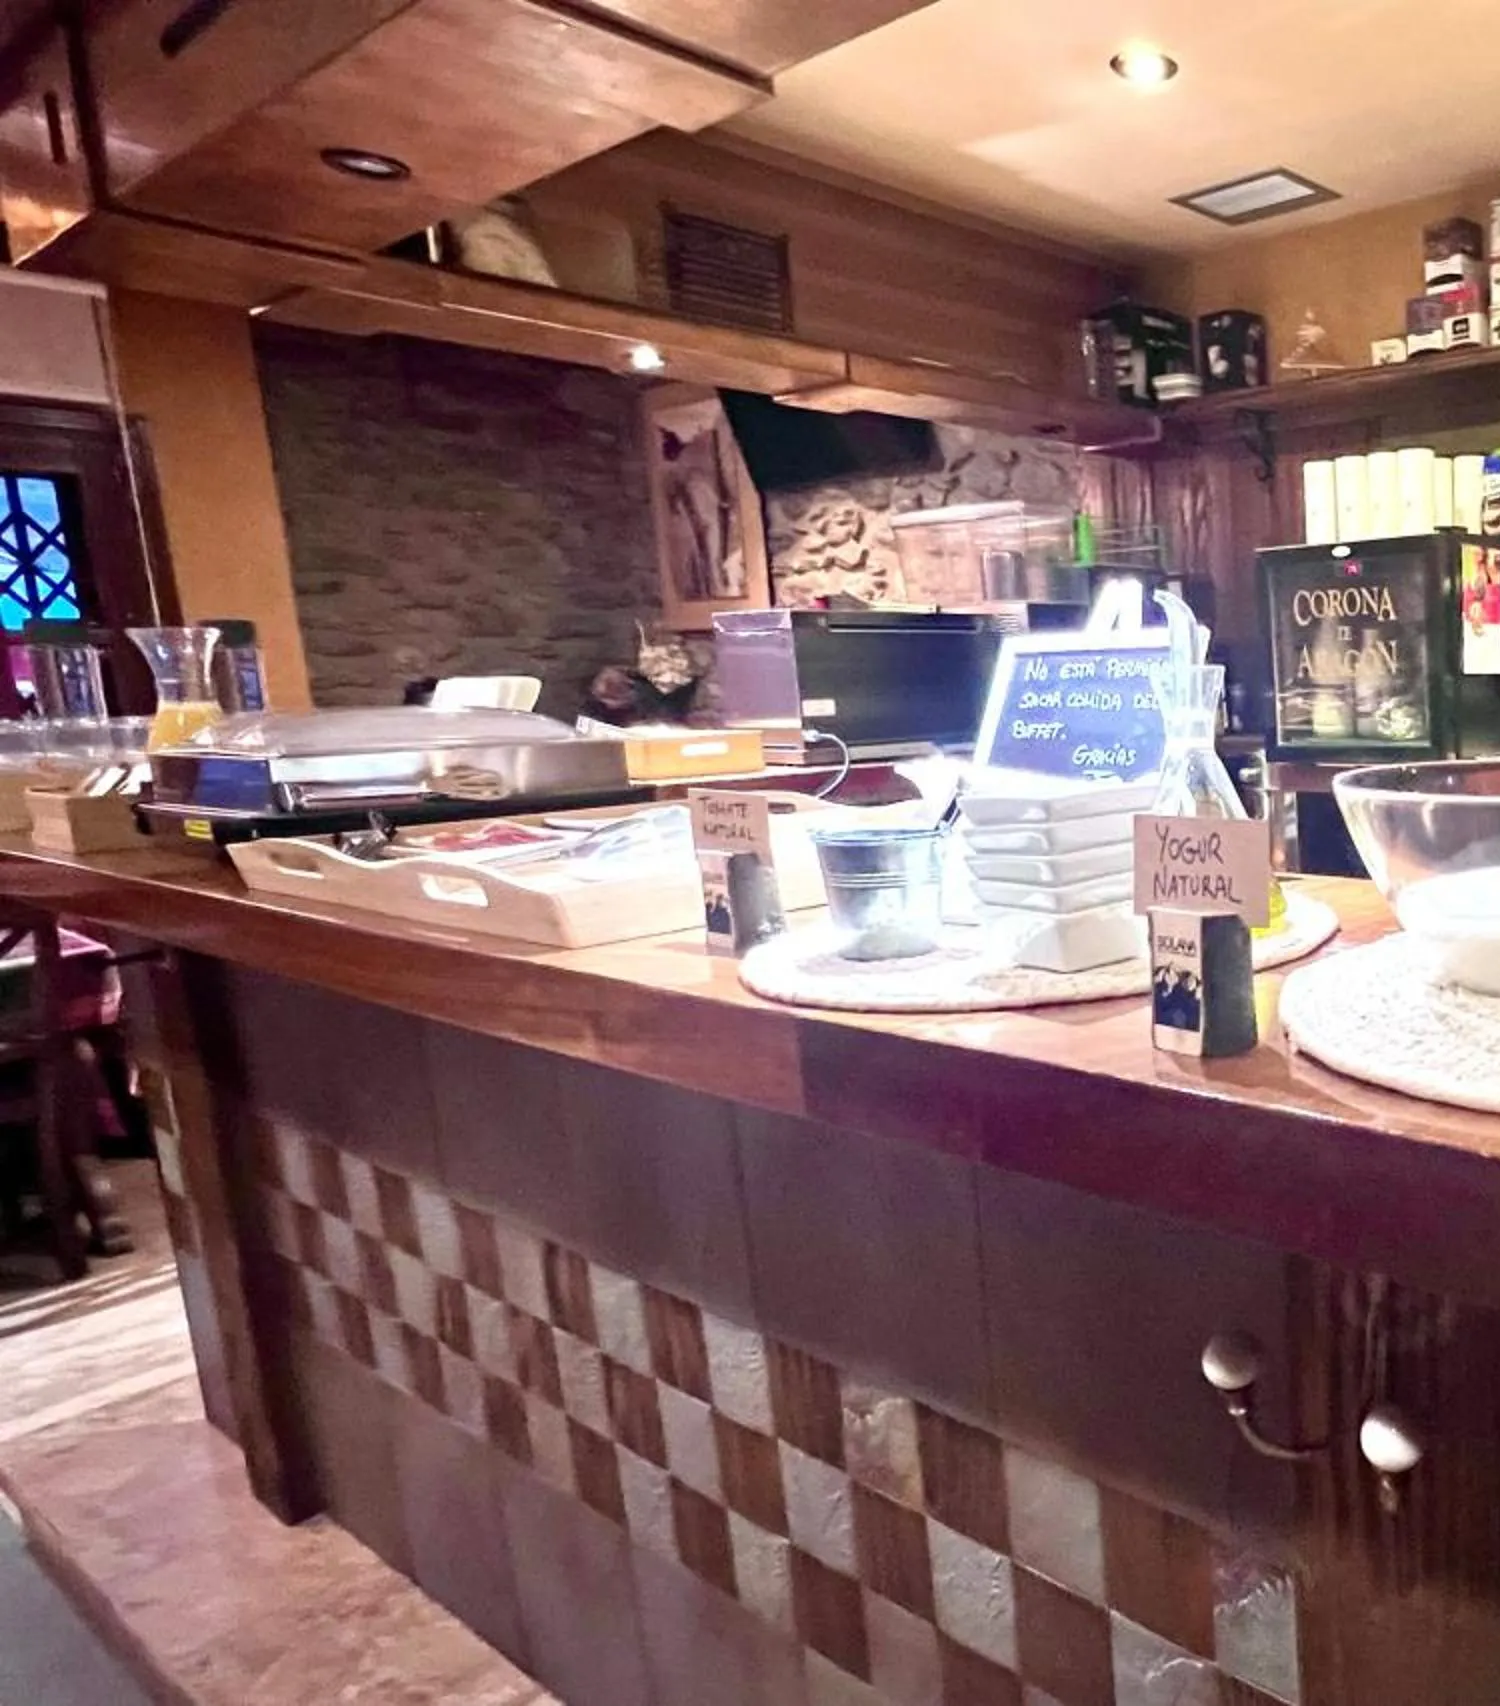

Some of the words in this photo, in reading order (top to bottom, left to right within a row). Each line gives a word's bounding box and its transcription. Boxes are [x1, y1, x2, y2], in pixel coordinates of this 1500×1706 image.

[1293, 586, 1397, 627] CORONA
[1154, 823, 1226, 865] YOGUR
[1152, 865, 1243, 904] NATURAL
